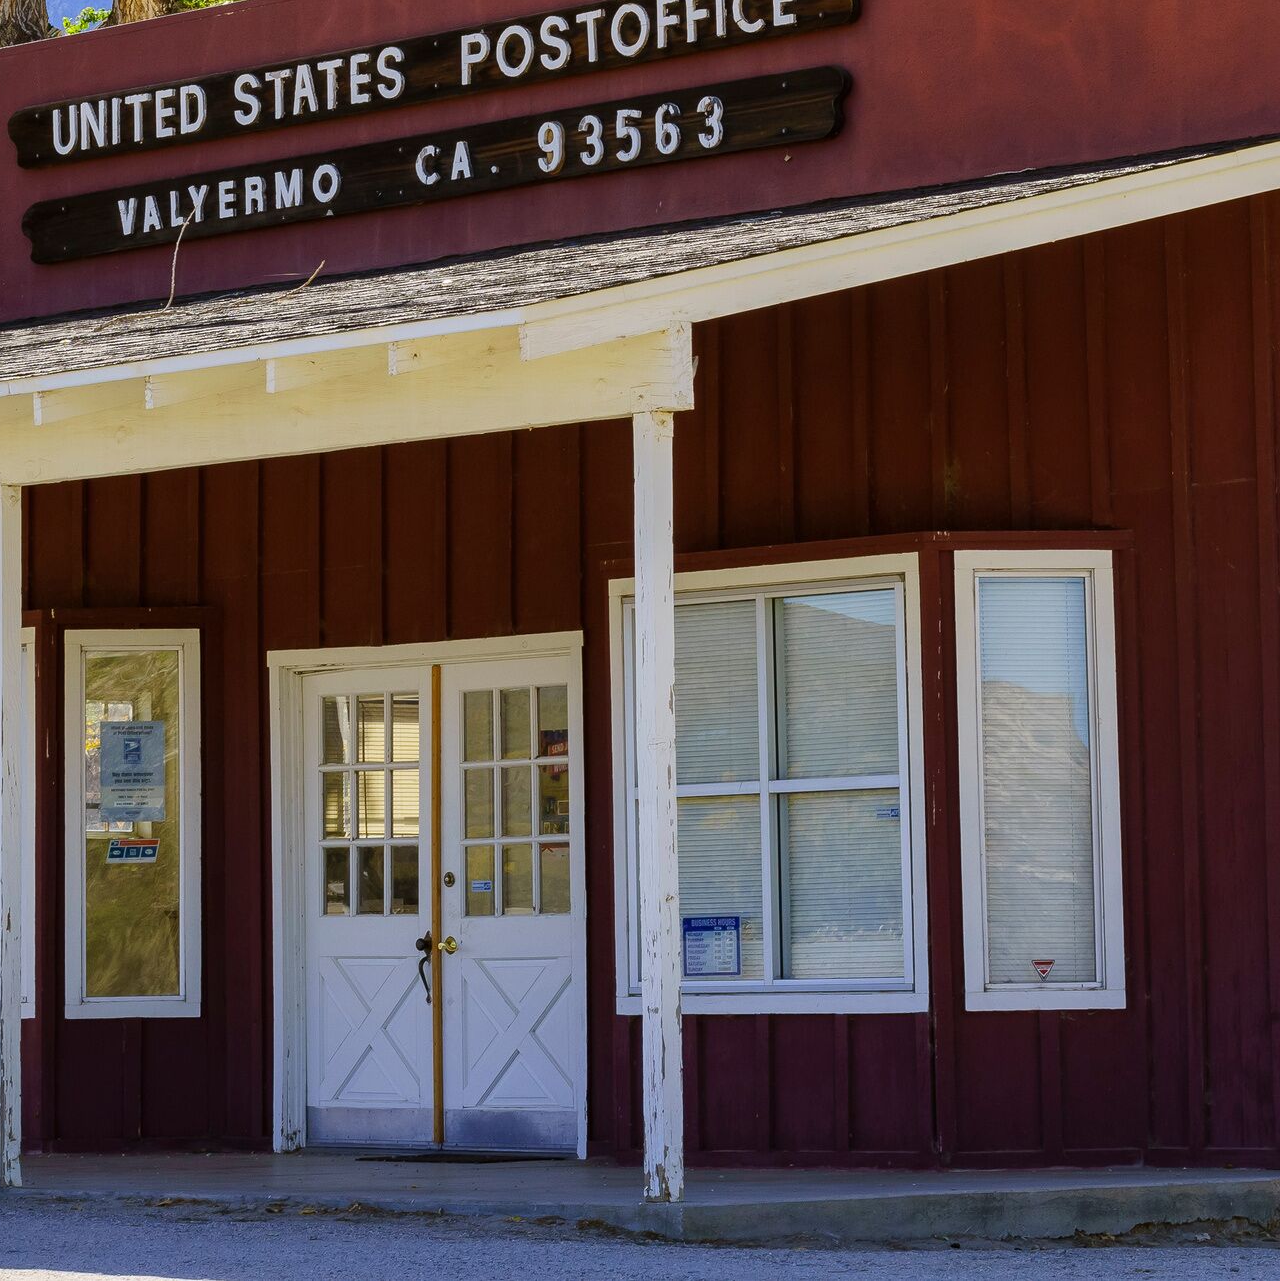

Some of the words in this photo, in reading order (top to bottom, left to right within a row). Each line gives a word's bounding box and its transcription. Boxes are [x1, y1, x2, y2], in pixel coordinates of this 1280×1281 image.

[52, 84, 207, 156] UNITED
[233, 46, 405, 126] STATES
[118, 163, 341, 236] VALYERMO
[415, 140, 500, 186] CA.
[537, 95, 724, 174] 93563
[718, 918, 736, 926] HOURS
